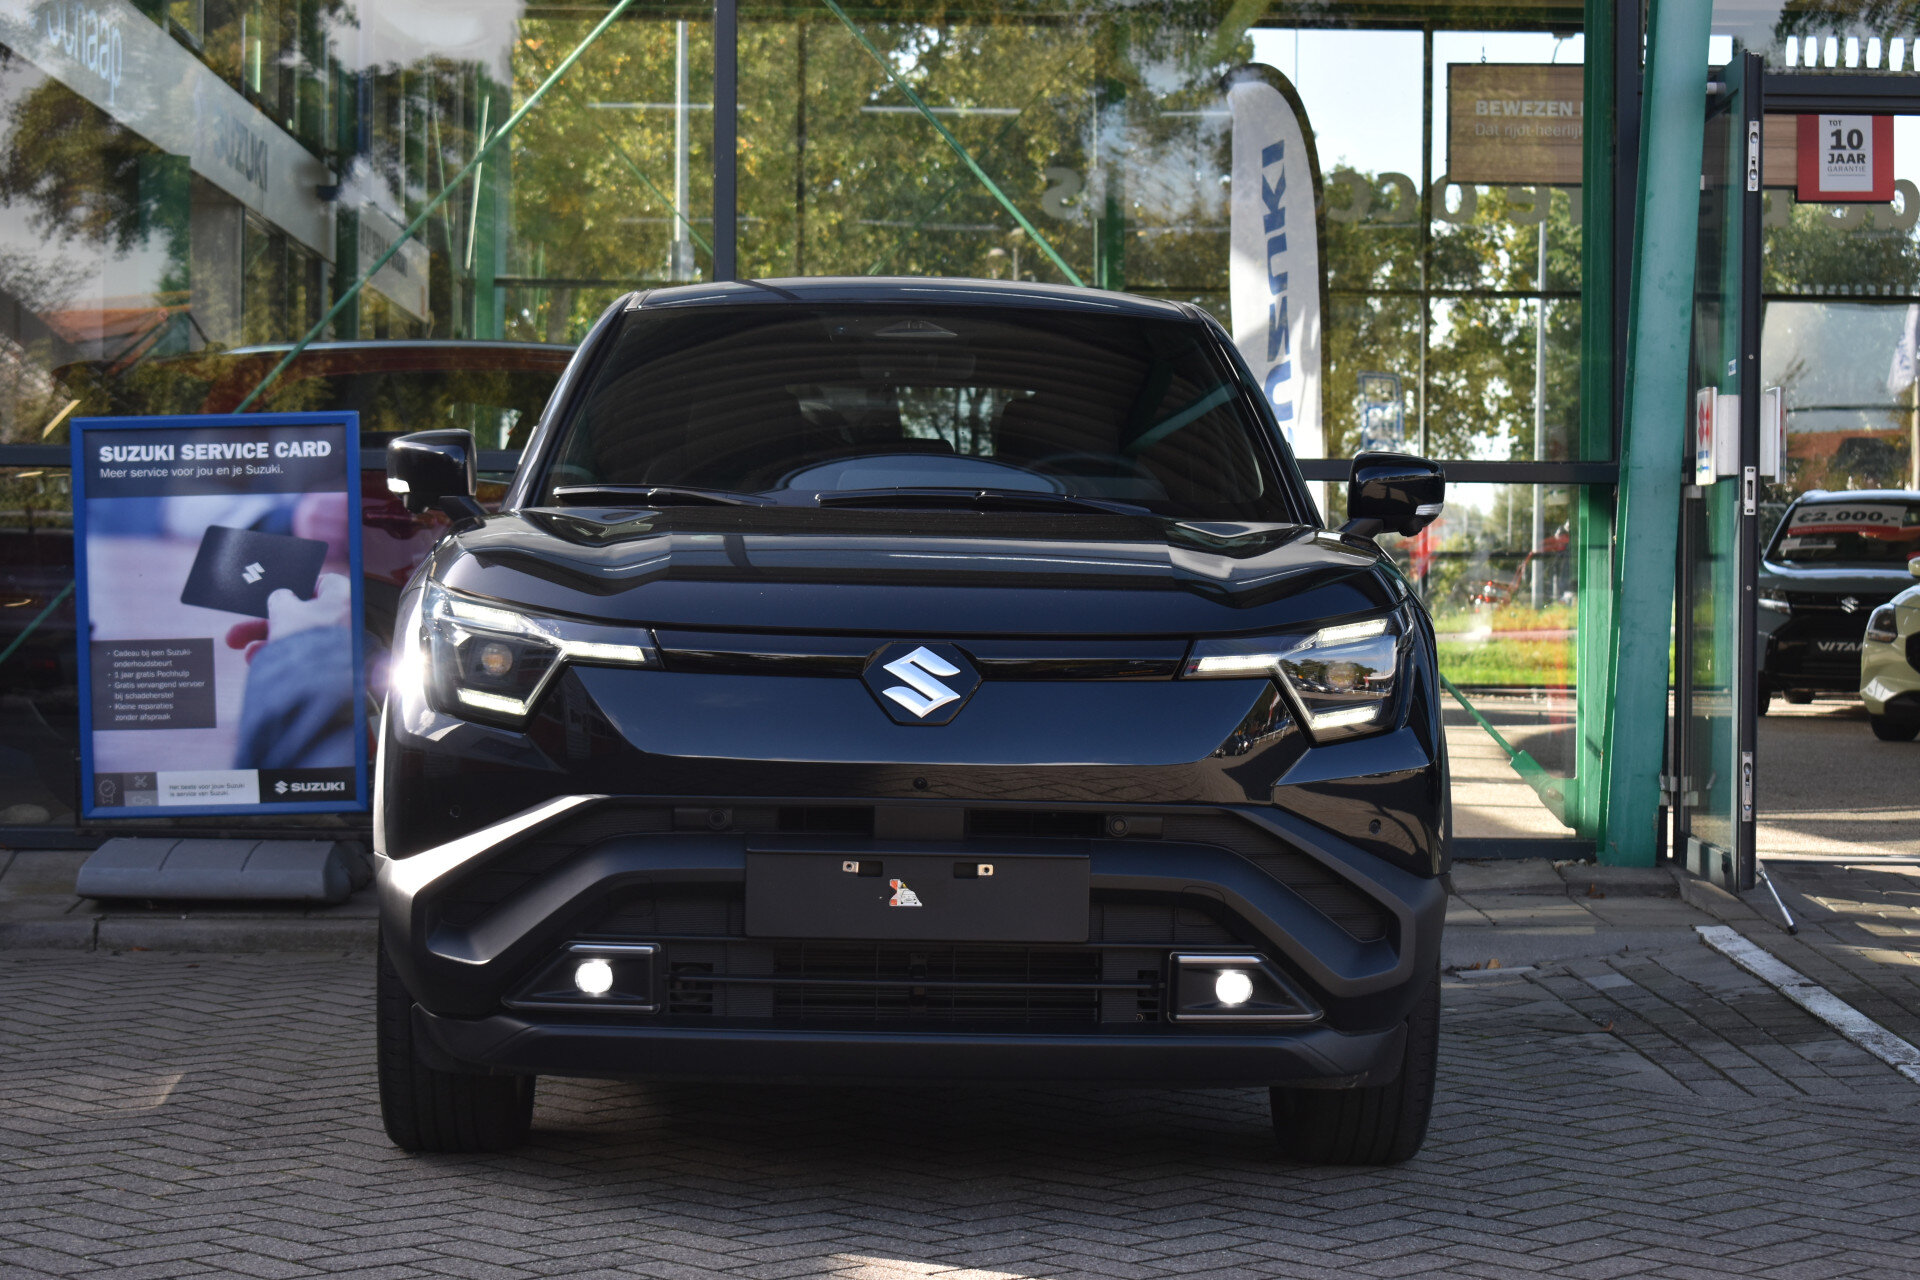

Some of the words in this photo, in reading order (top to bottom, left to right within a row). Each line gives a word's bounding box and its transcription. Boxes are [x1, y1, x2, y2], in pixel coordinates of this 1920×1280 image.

[1475, 101, 1573, 117] BEWEZEN
[1475, 122, 1499, 136] Dat
[1504, 122, 1531, 139] rijdt
[1830, 129, 1864, 150] 10
[1827, 153, 1866, 164] JAAR
[1827, 165, 1866, 173] GARANTIE
[1261, 139, 1294, 442] UZUKI
[100, 445, 175, 462] SUZUKI
[181, 443, 269, 461] SERVICE
[274, 441, 332, 458] CARD
[100, 468, 127, 478] Meer
[130, 468, 168, 478] service
[172, 468, 194, 477] voor
[196, 466, 213, 478] jou
[216, 467, 230, 476] en
[232, 466, 242, 478] je
[246, 464, 284, 475] Suzuki.
[1797, 511, 1898, 526] €2.000,-
[113, 649, 140, 657] Cadeau
[141, 649, 150, 658] bij
[114, 660, 173, 668] onderhoudsbeurt
[121, 671, 134, 679] jaar
[136, 671, 155, 680] gratis
[157, 670, 190, 679] Pechhulp
[114, 681, 135, 689] Gratis
[137, 681, 177, 690] vervangend
[115, 692, 123, 701] bij
[125, 691, 174, 699] schadeherstel
[138, 703, 174, 711] reparaties
[140, 713, 171, 721] afspraak
[291, 781, 346, 792] SUZUKI
